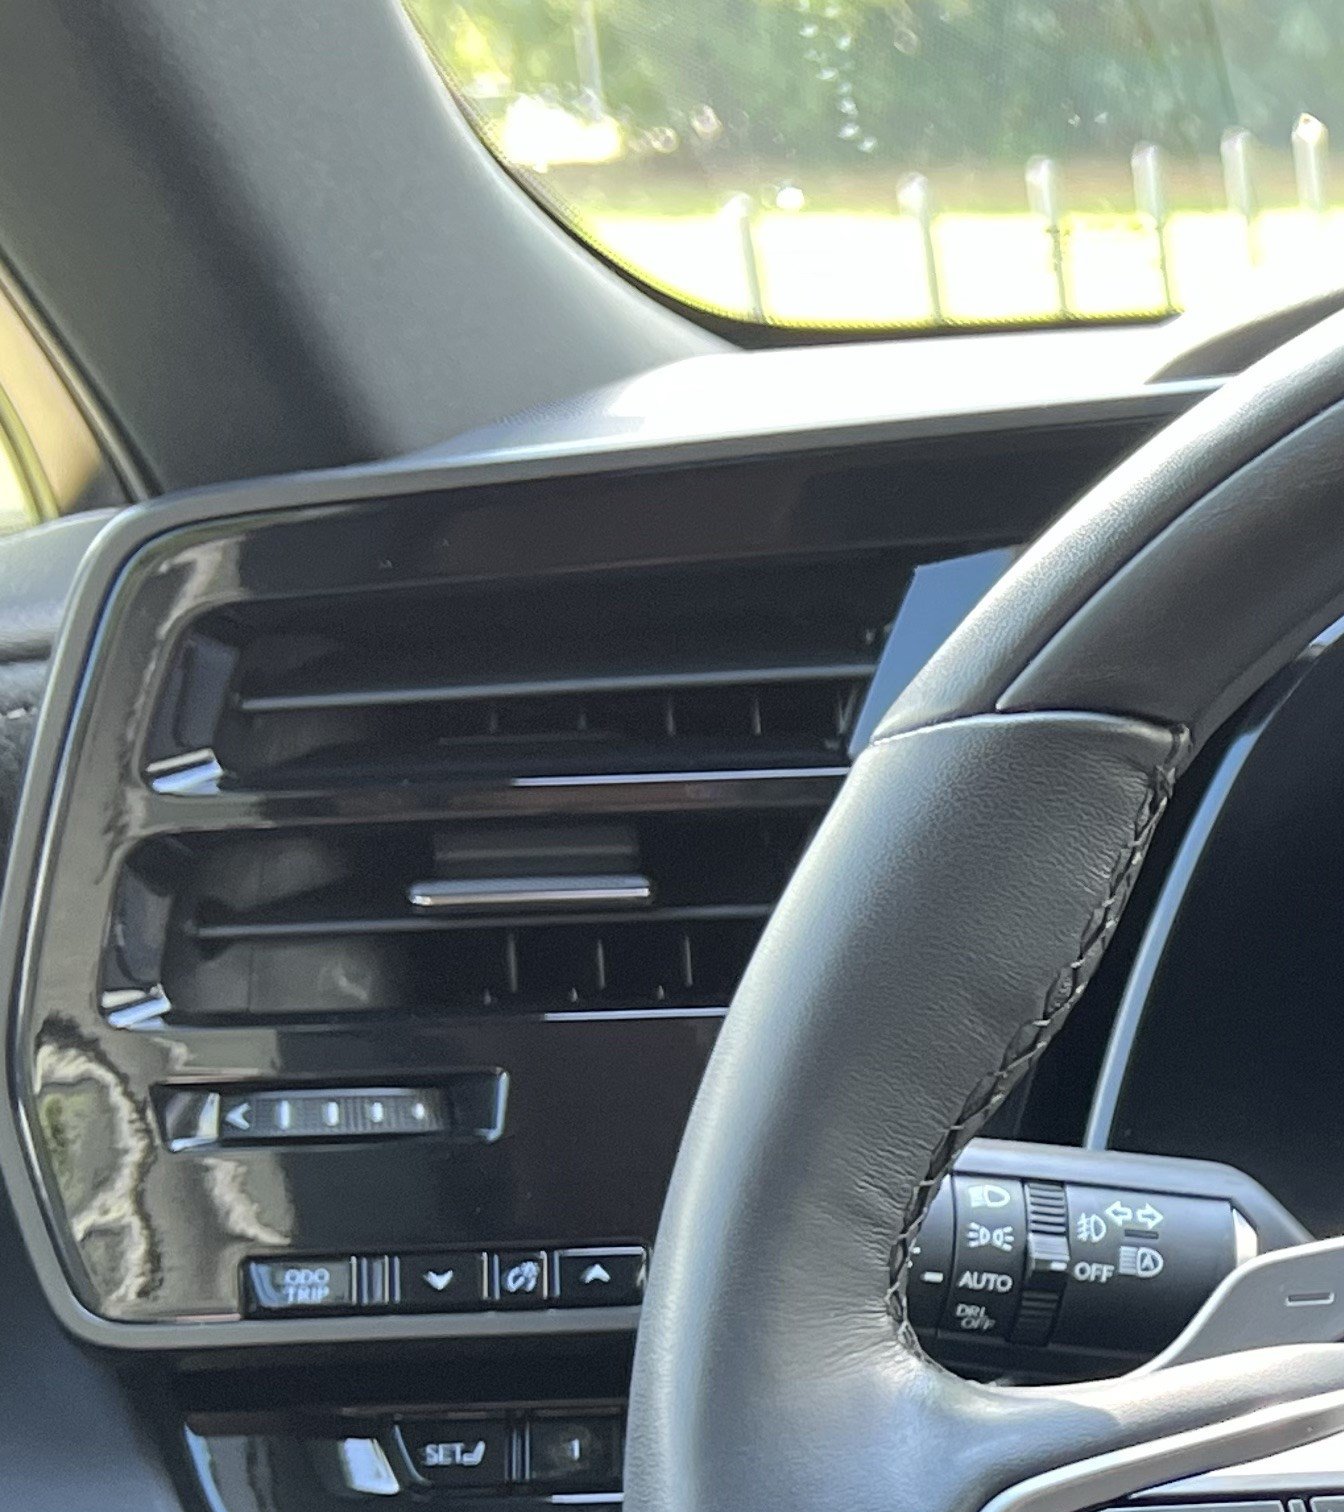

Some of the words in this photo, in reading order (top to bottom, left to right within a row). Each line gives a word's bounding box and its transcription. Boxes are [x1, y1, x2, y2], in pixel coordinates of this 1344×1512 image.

[958, 1270, 1013, 1292] AUTO
[1074, 1262, 1115, 1283] OFF
[287, 1286, 330, 1304] TRIP
[425, 1442, 464, 1466] SET
